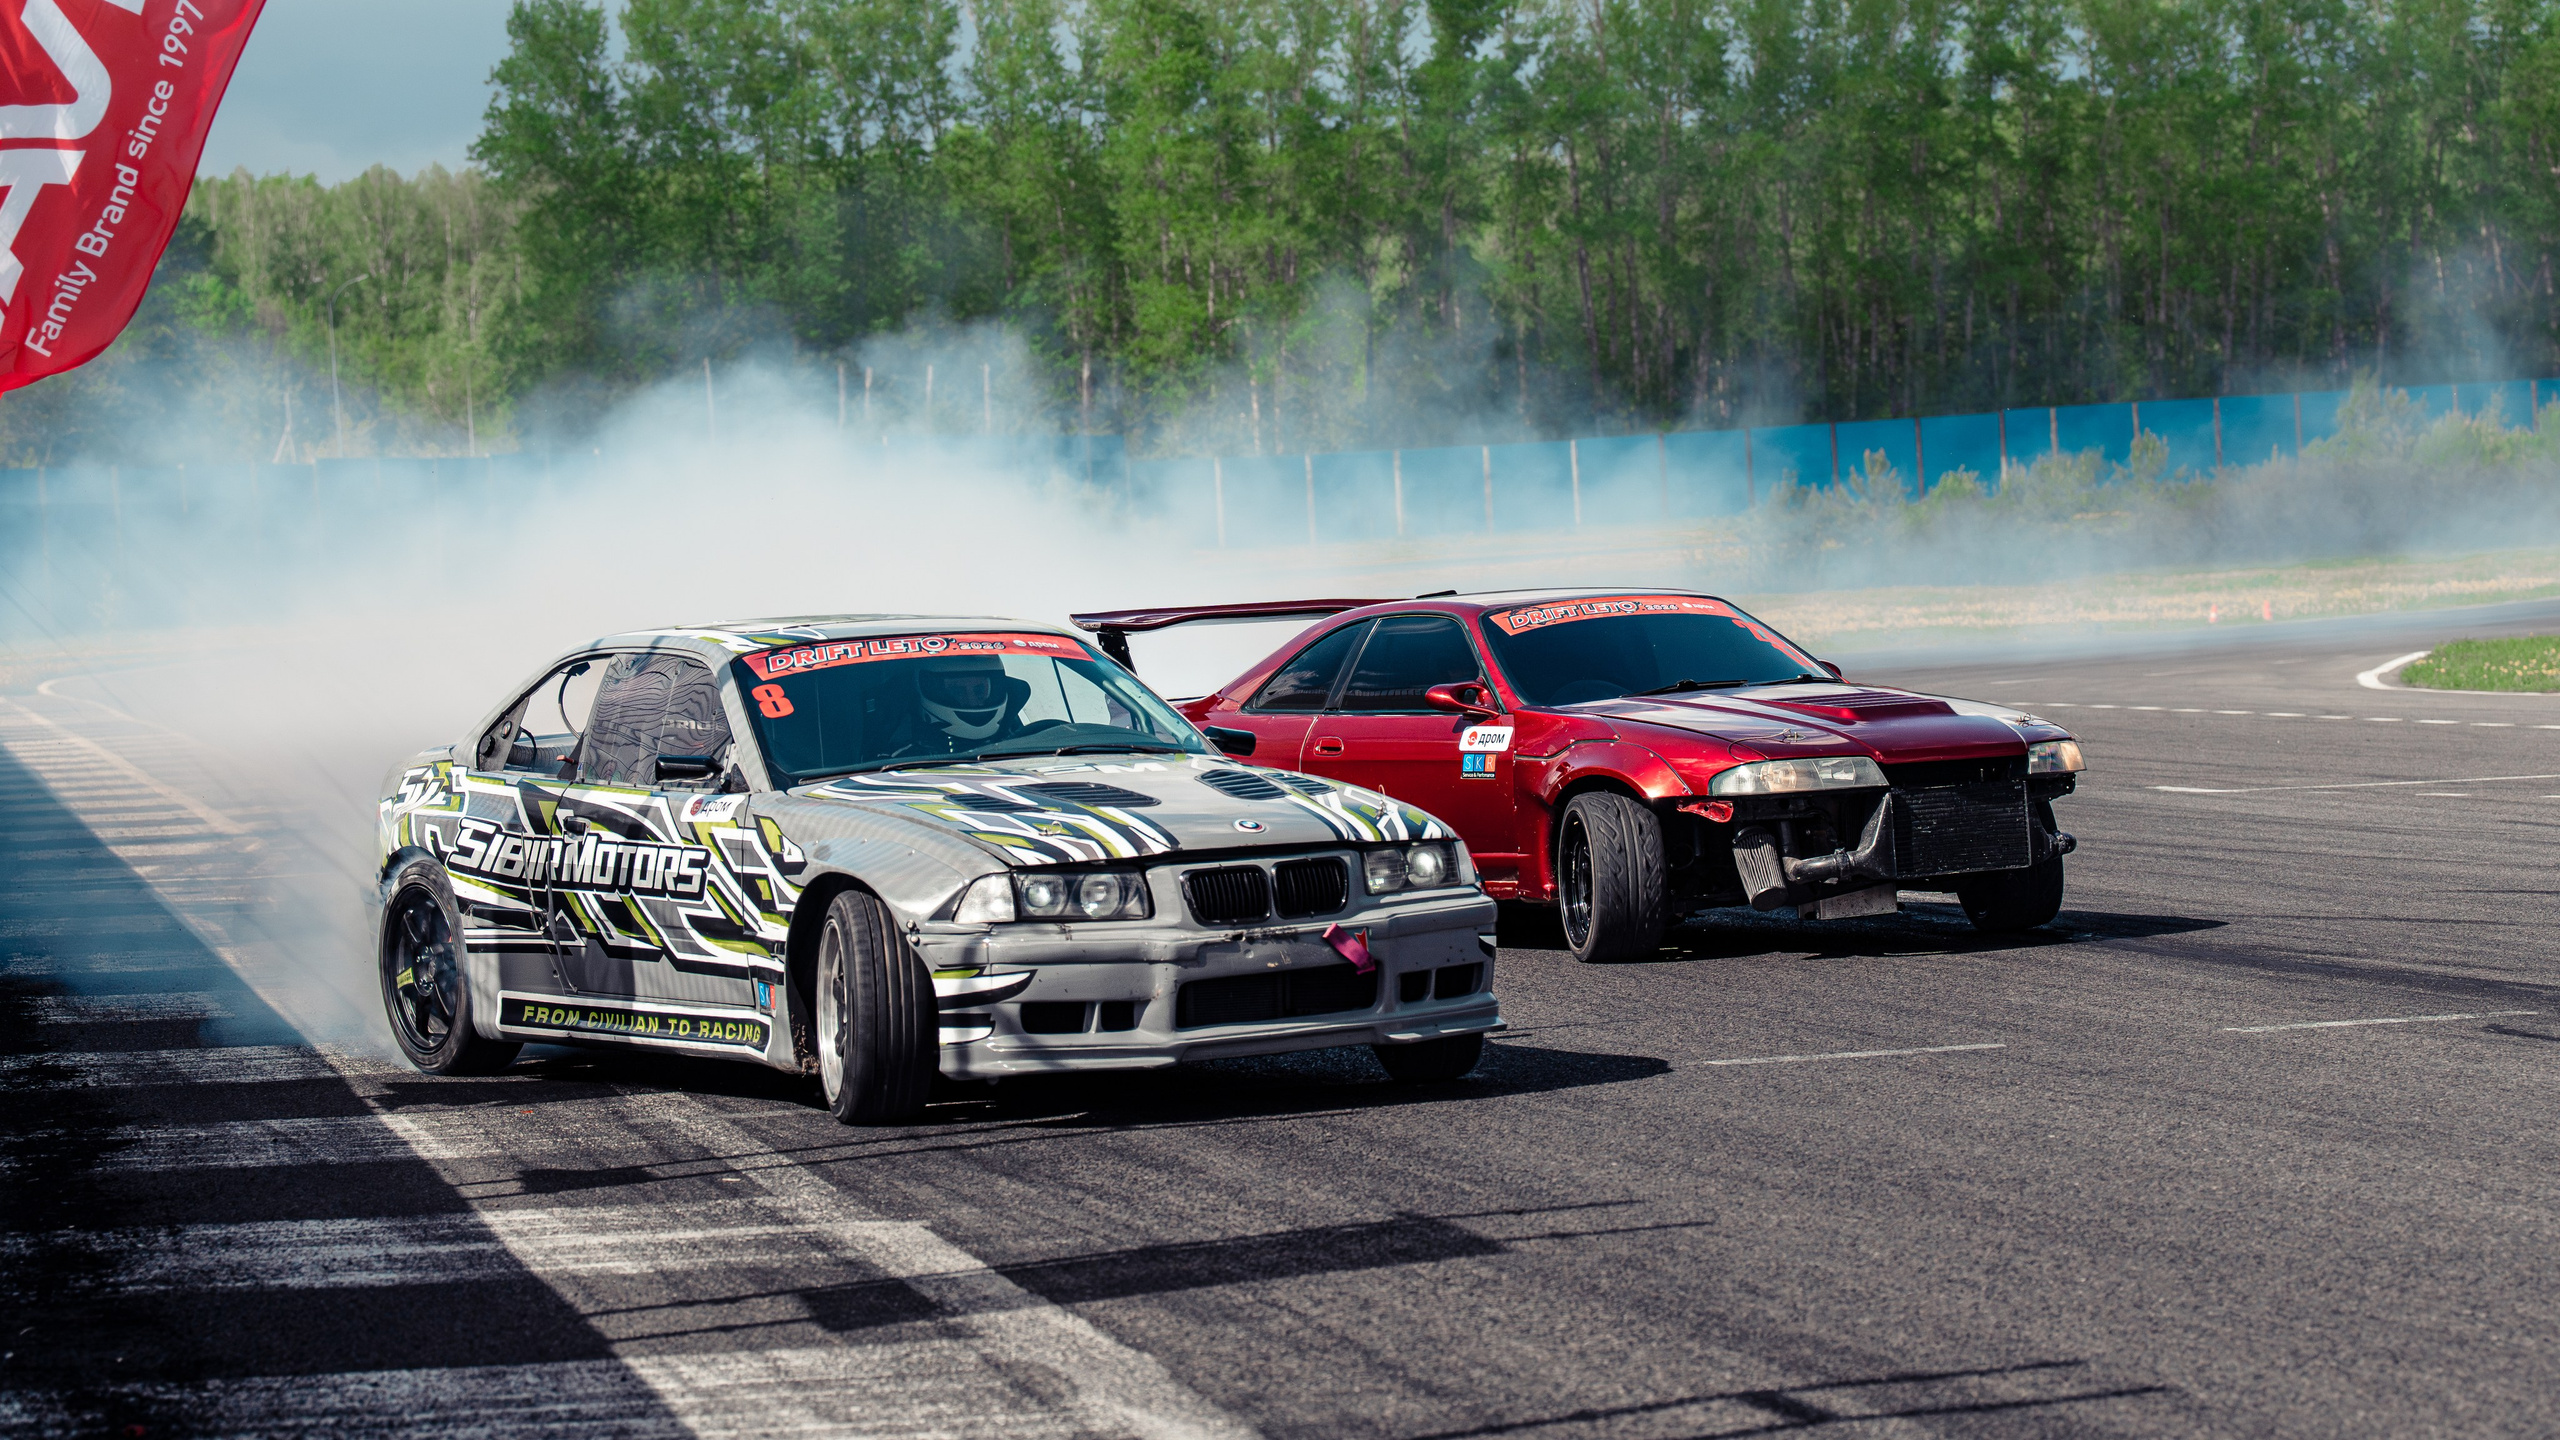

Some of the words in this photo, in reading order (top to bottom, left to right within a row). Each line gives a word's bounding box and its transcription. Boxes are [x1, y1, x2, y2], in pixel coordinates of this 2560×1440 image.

[25, 260, 97, 358] Family
[75, 163, 139, 258] Brand
[128, 80, 174, 160] since
[159, 0, 204, 67] 1997
[1509, 605, 1578, 629] DRIFT
[1580, 600, 1638, 615] LETO
[768, 641, 865, 673] DRIFT
[868, 636, 948, 656] LETO
[958, 641, 1006, 650] 2026
[751, 683, 795, 719] 8
[1464, 755, 1494, 770] SKR
[522, 1005, 580, 1027] FROM
[587, 1011, 659, 1034] CIVILIAN
[667, 1018, 691, 1036] TO
[698, 1020, 761, 1043] RACING
